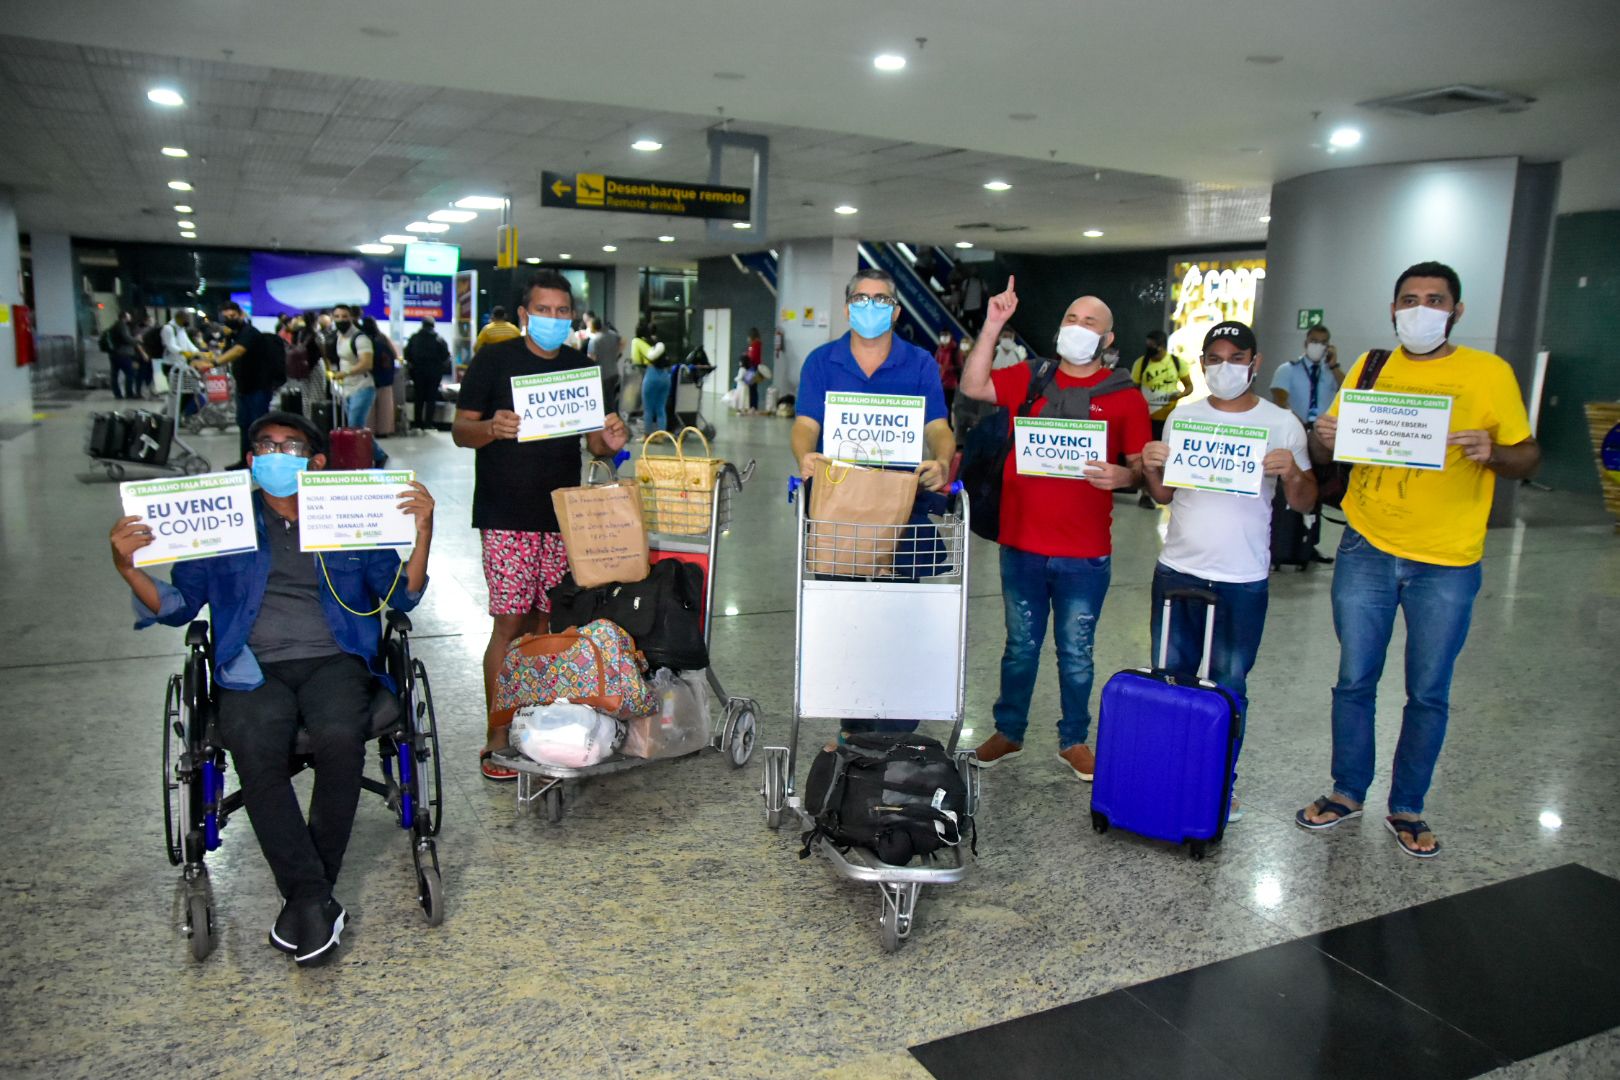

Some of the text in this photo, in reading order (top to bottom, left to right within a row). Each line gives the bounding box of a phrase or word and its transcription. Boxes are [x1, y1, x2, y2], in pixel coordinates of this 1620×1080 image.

[607, 181, 745, 204] Desembarque remoto
[607, 198, 685, 212] Remote arrivals
[521, 376, 552, 385] TRABALHO
[528, 386, 589, 405] EU VENCI
[837, 396, 870, 404] TRABALHO
[1353, 395, 1388, 403] TRABALHO
[1406, 398, 1422, 406] PELA
[1423, 399, 1446, 407] GENTE
[523, 399, 597, 420] A COVID-19
[1369, 405, 1419, 416] OBRIGADO
[841, 412, 909, 427] EU VENCI
[832, 427, 915, 444] A COVID-19
[1181, 423, 1213, 432] TRABALHO
[1229, 428, 1244, 436] PELA
[1244, 429, 1265, 437] GENTE
[1374, 428, 1388, 436] SÃO
[1389, 430, 1419, 439] CHIBATA
[1029, 433, 1091, 448] EU VENCI
[1183, 438, 1251, 457] EU VENCI
[1379, 439, 1400, 447] BALDE
[1023, 446, 1099, 461] A COVID-19
[1173, 453, 1256, 474] A COVID-19
[137, 483, 180, 495] TRABALHO
[199, 479, 217, 488] PELA
[217, 477, 243, 486] GENTE
[312, 476, 351, 484] TRABALHO
[385, 474, 407, 482] GENTE
[147, 496, 233, 519] EU VENCI
[159, 512, 244, 536] COVID-19
